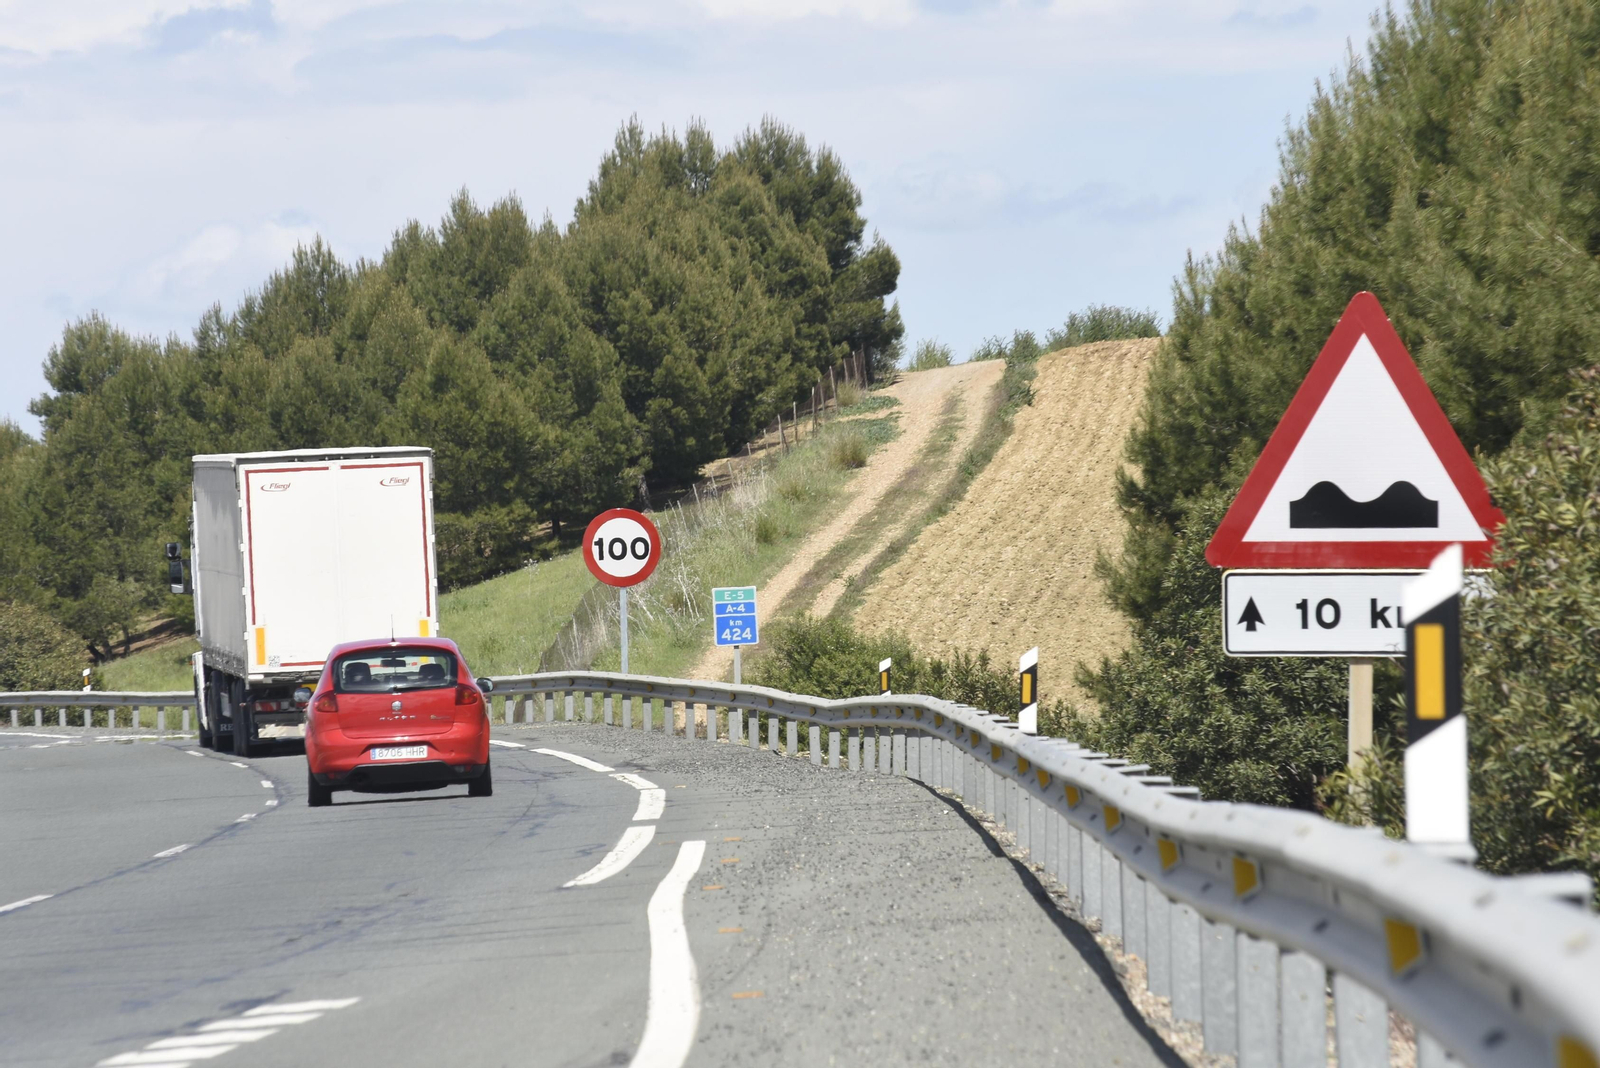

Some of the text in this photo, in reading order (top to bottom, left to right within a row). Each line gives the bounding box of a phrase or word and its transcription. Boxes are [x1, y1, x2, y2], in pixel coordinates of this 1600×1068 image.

[594, 537, 649, 560] 100
[724, 591, 744, 600] E-5
[726, 604, 745, 613] A-4
[1296, 598, 1405, 629] 10 k
[721, 627, 752, 641] 424
[378, 748, 403, 758] 8706
[405, 746, 425, 756] HHR
